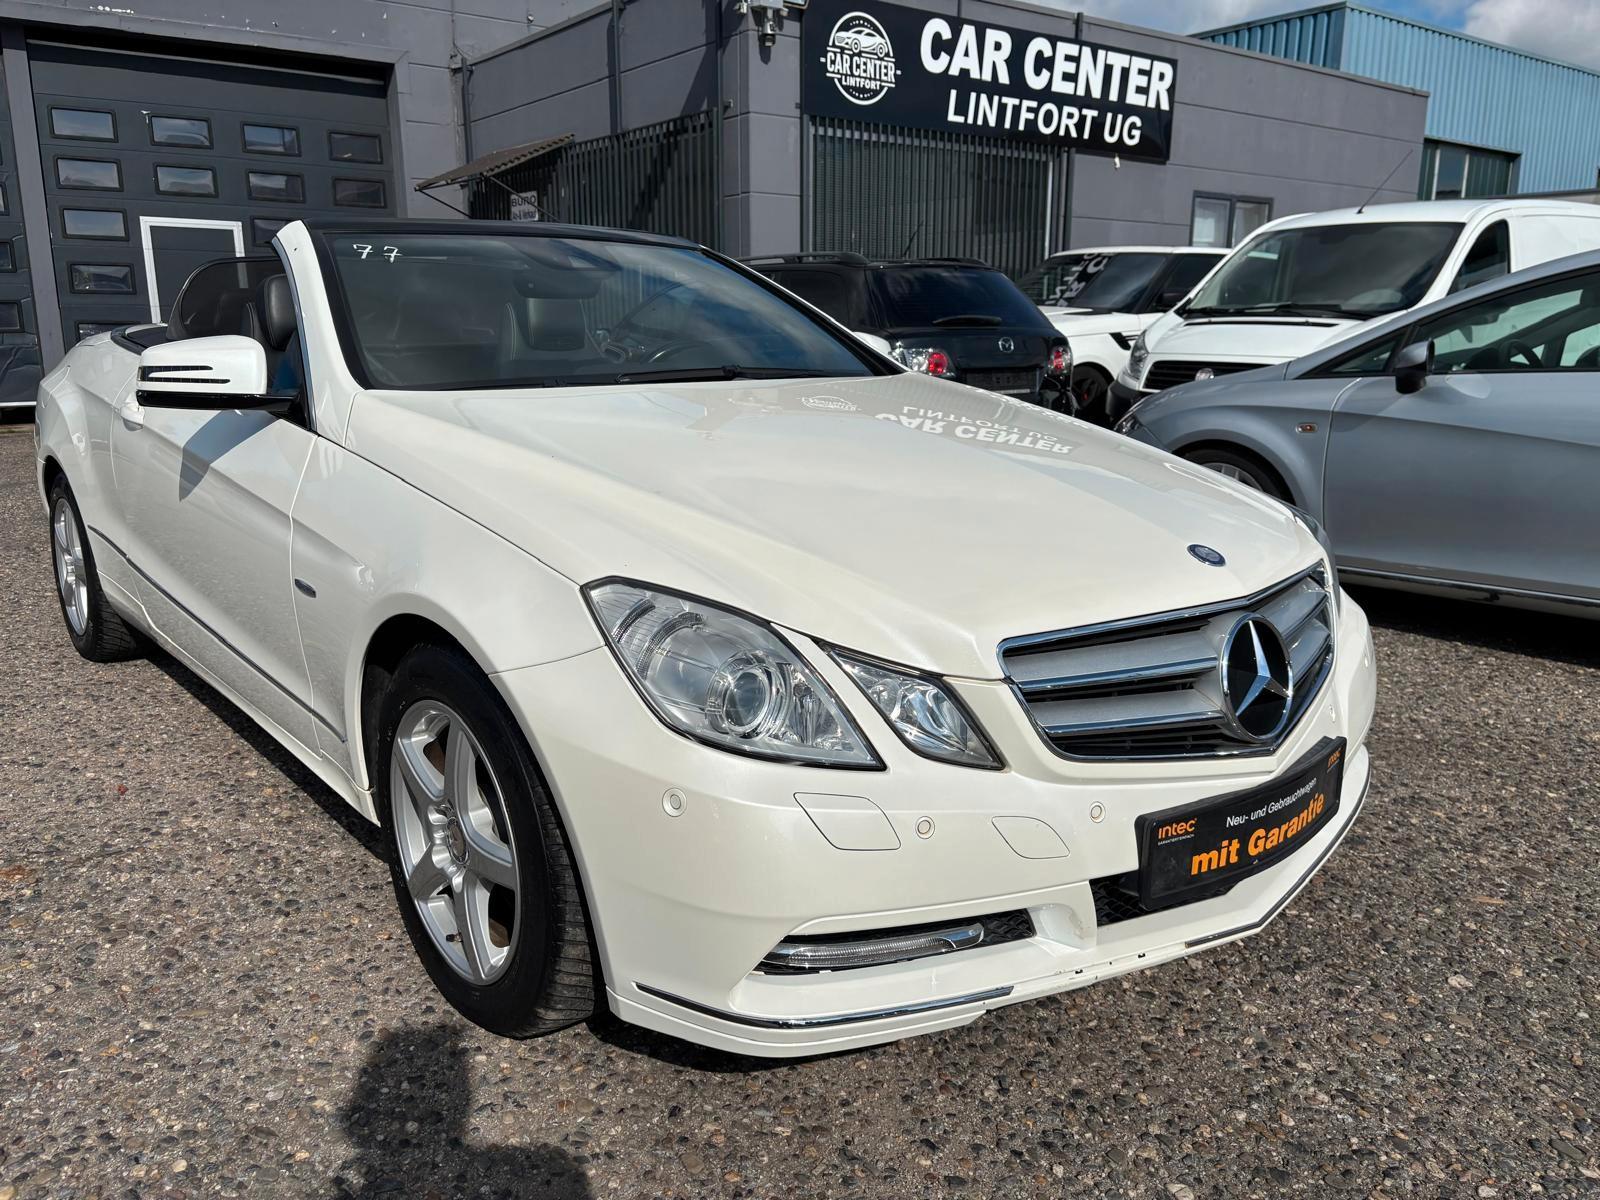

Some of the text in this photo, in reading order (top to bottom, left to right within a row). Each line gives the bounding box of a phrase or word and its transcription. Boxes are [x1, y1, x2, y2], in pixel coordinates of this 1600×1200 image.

[826, 51, 896, 83] CAR CENTER
[841, 75, 881, 90] LINTFORT
[920, 17, 1174, 111] CAR CENTER
[946, 88, 1142, 147] LINTFORT UG
[1226, 777, 1317, 828] Neu- und Gebrauchtwagen
[1158, 819, 1196, 840] intec
[1190, 792, 1325, 876] mit Garantie
